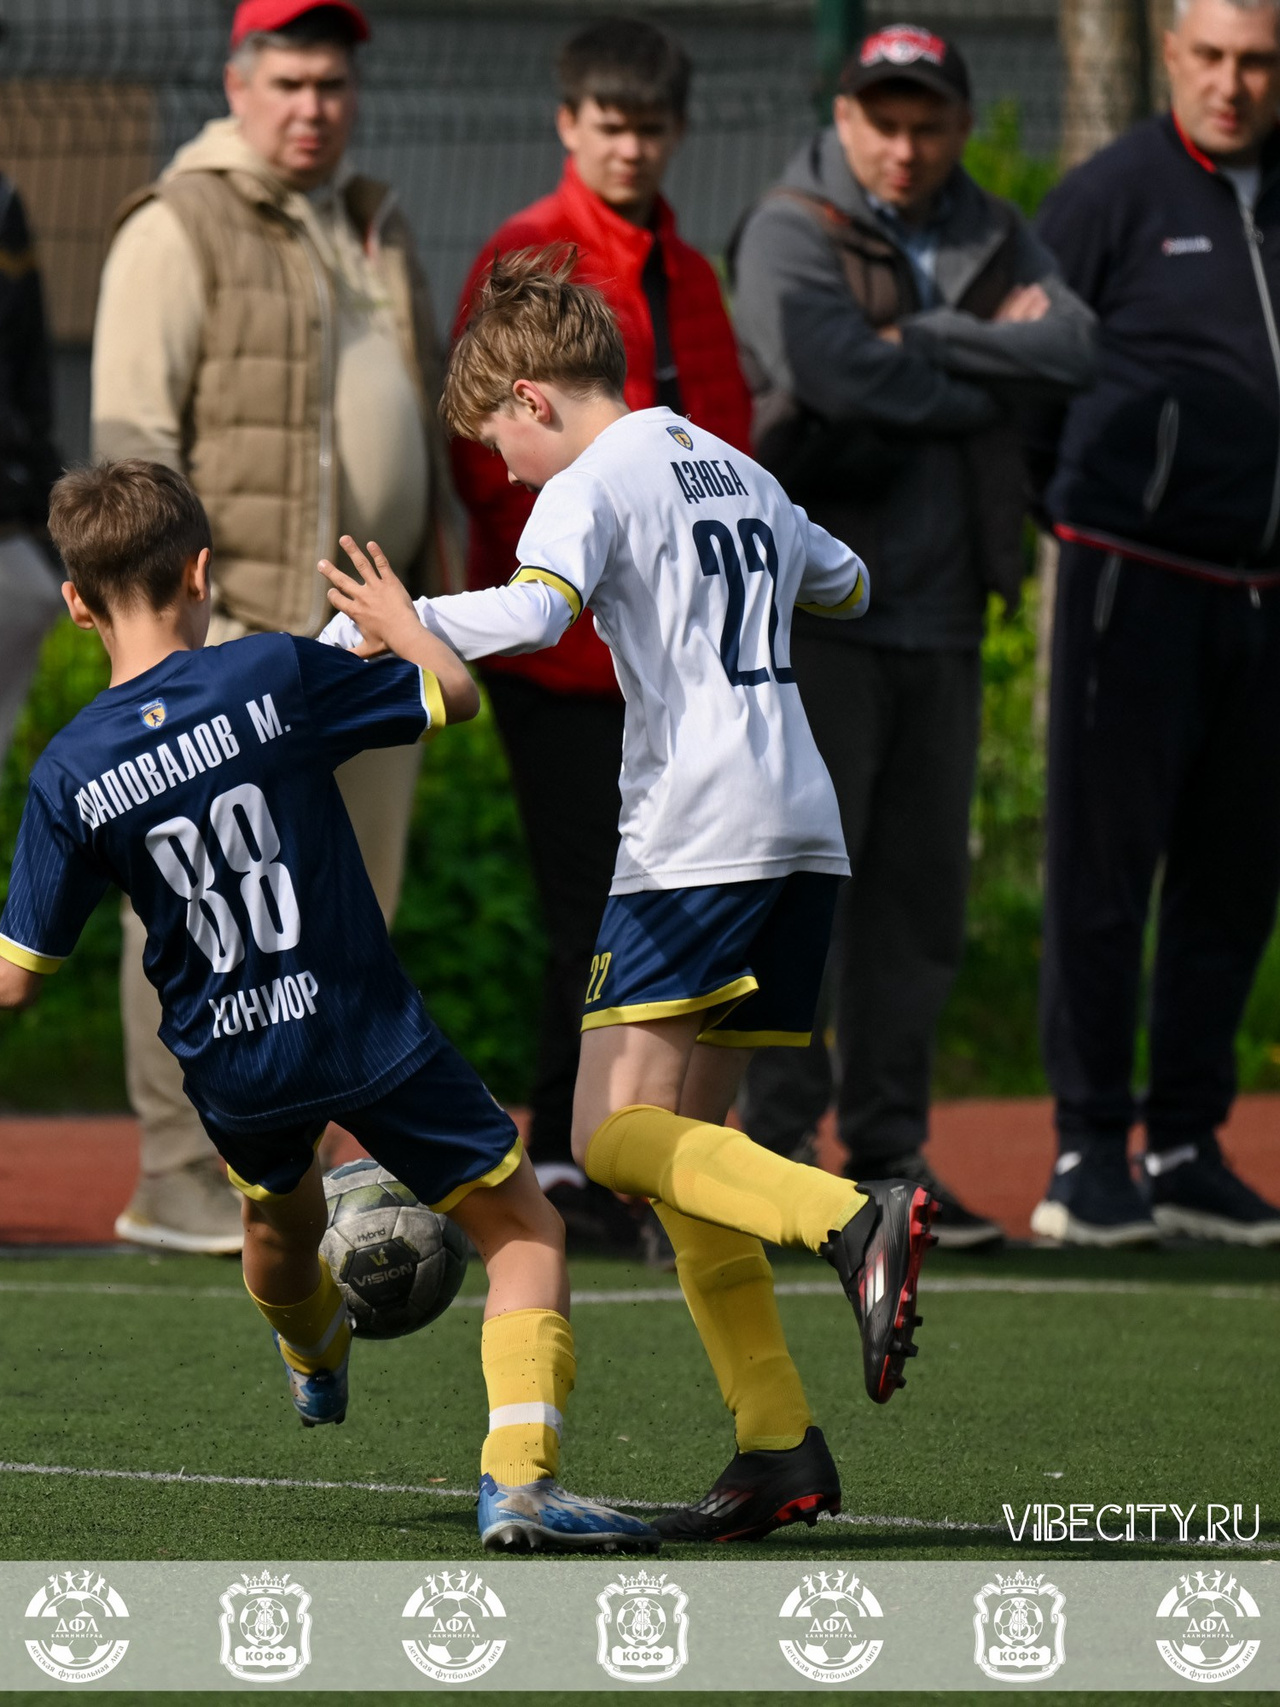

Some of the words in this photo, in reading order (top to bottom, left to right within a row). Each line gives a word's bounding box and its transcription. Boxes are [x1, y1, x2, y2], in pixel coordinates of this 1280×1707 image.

[670, 459, 750, 504] ДЗЮБА
[692, 517, 798, 687] 22
[245, 693, 292, 744] М.
[144, 782, 301, 974] 88
[208, 970, 320, 1039] ЮНИОР
[584, 951, 612, 1005] 22
[357, 1228, 386, 1242] Hybrid
